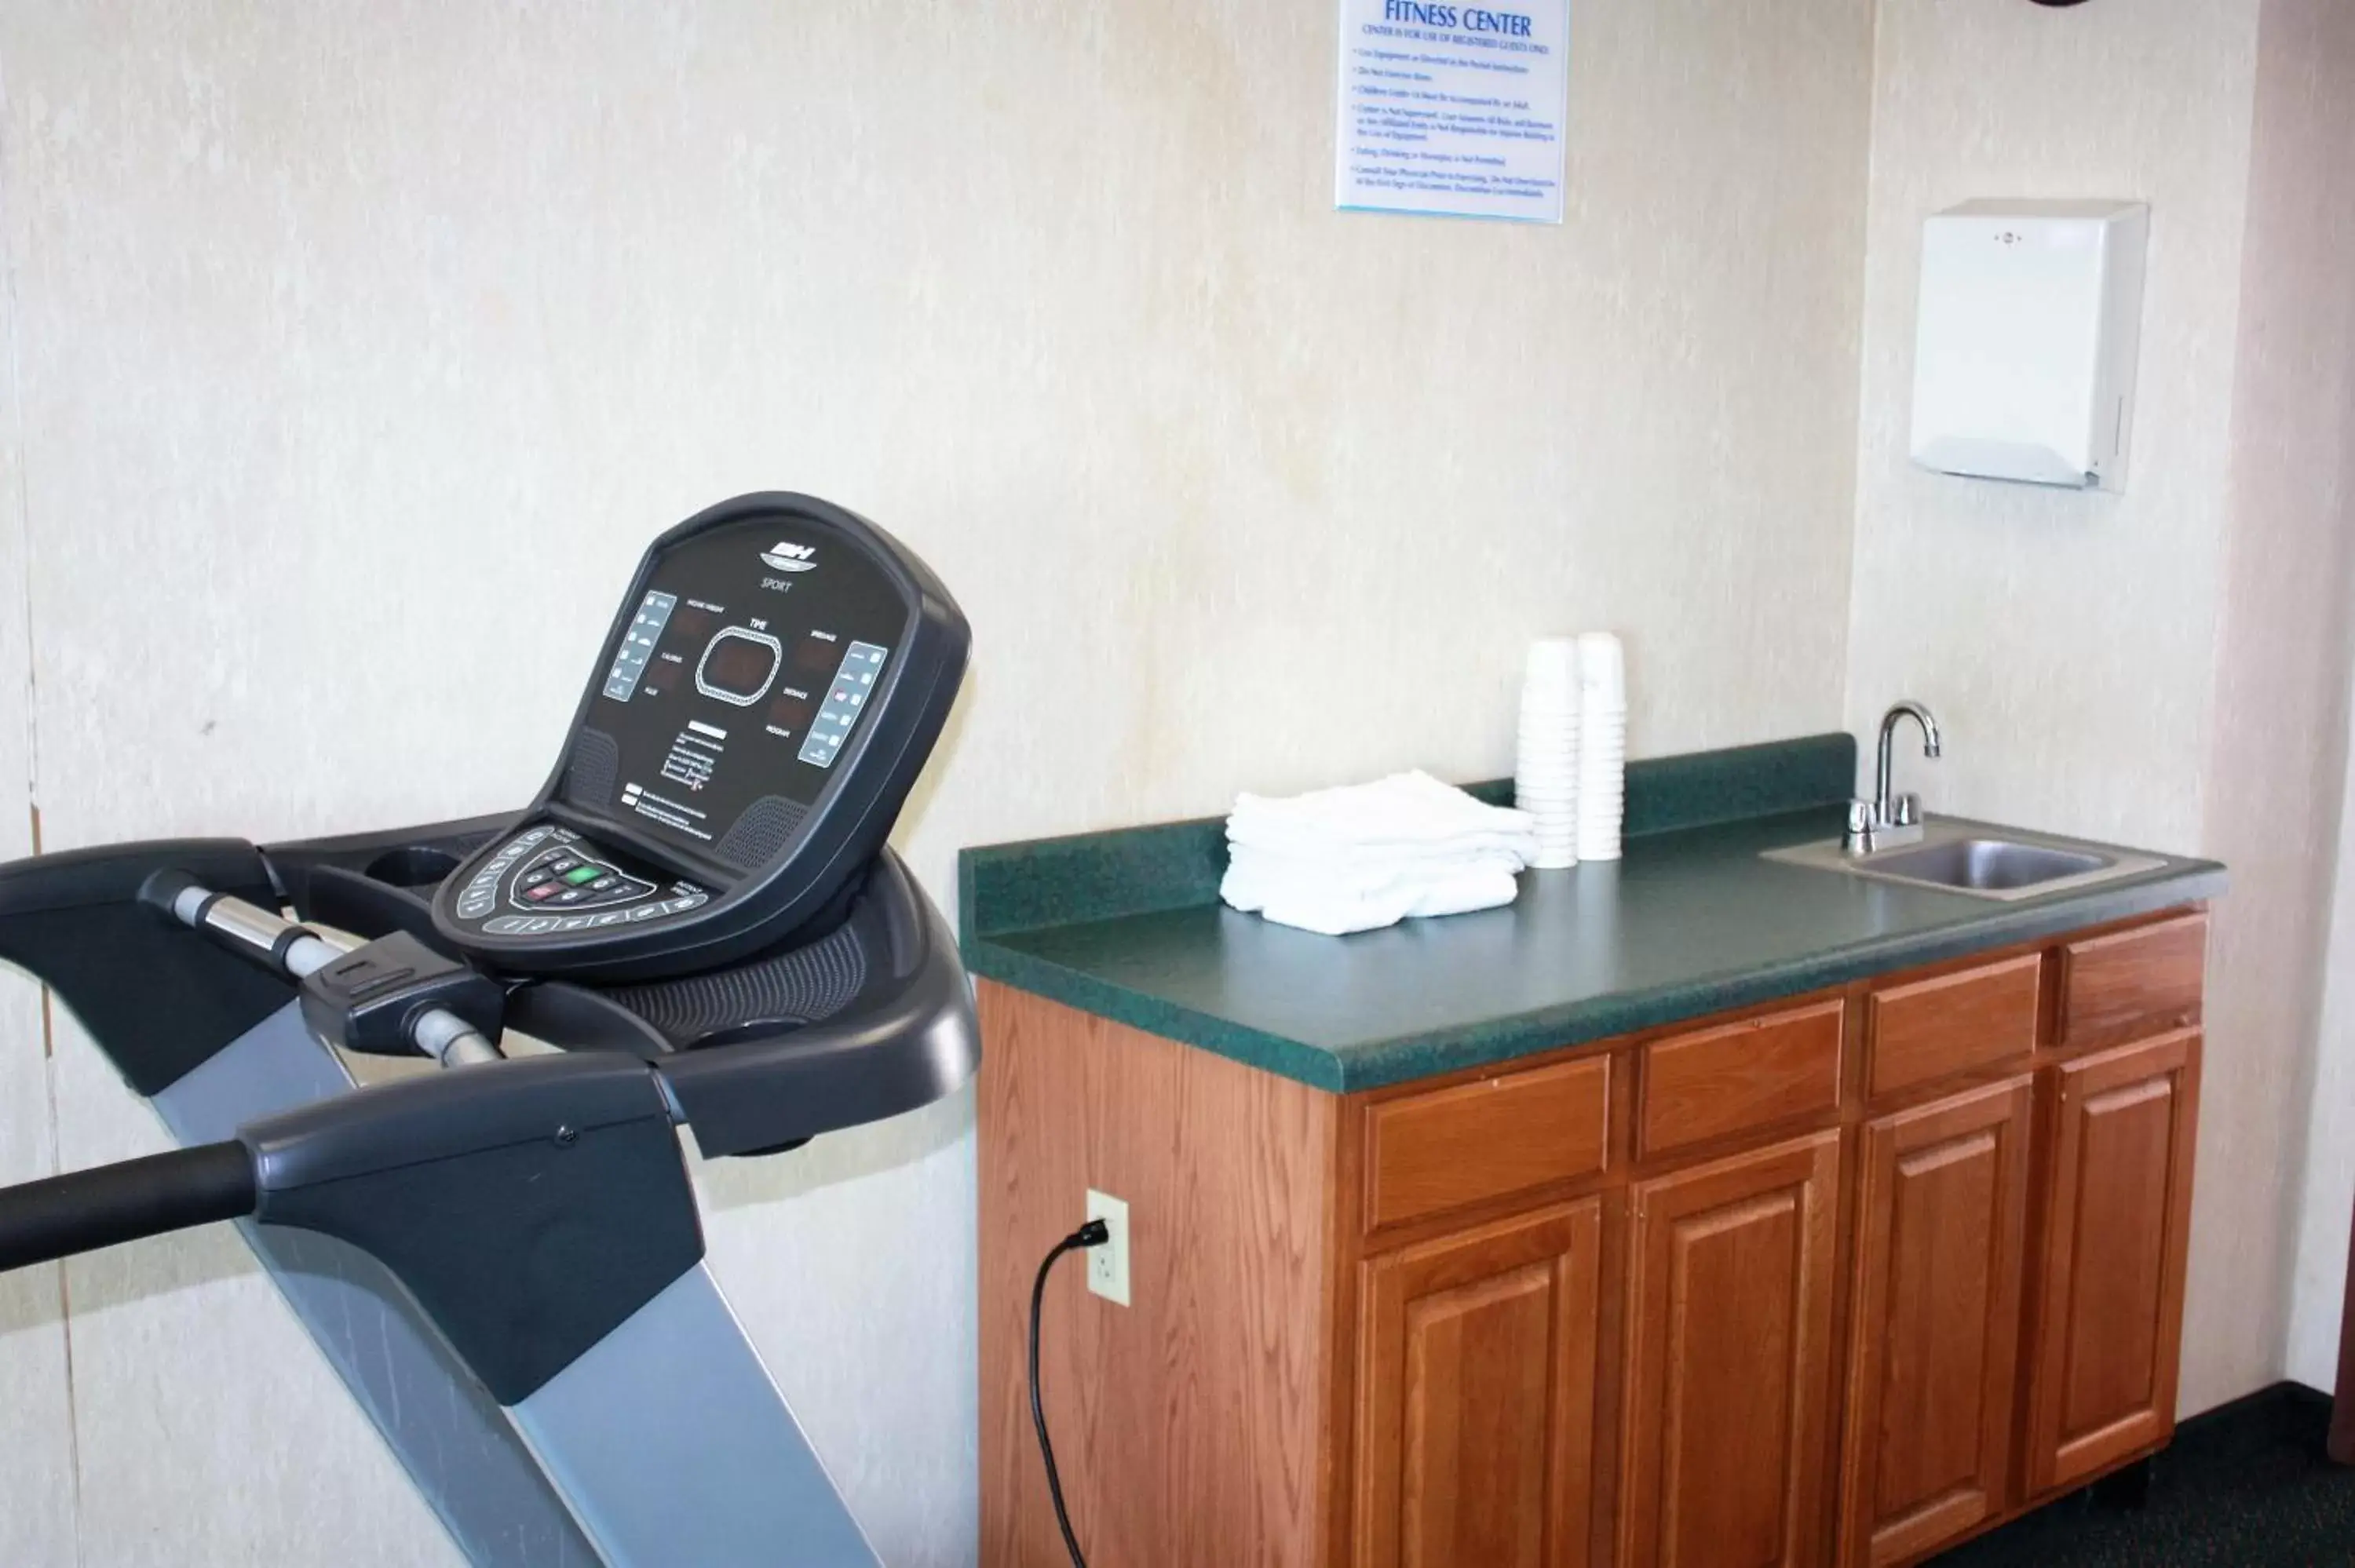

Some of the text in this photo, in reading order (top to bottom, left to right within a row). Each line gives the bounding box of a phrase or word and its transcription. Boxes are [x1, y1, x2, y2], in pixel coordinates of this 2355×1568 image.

[1385, 0, 1532, 37] FITNESS CENTER
[1362, 24, 1393, 36] CENTER
[1404, 29, 1421, 39] FOR
[1422, 31, 1437, 41] USE
[1438, 33, 1450, 42] OF
[760, 577, 794, 594] SPORT
